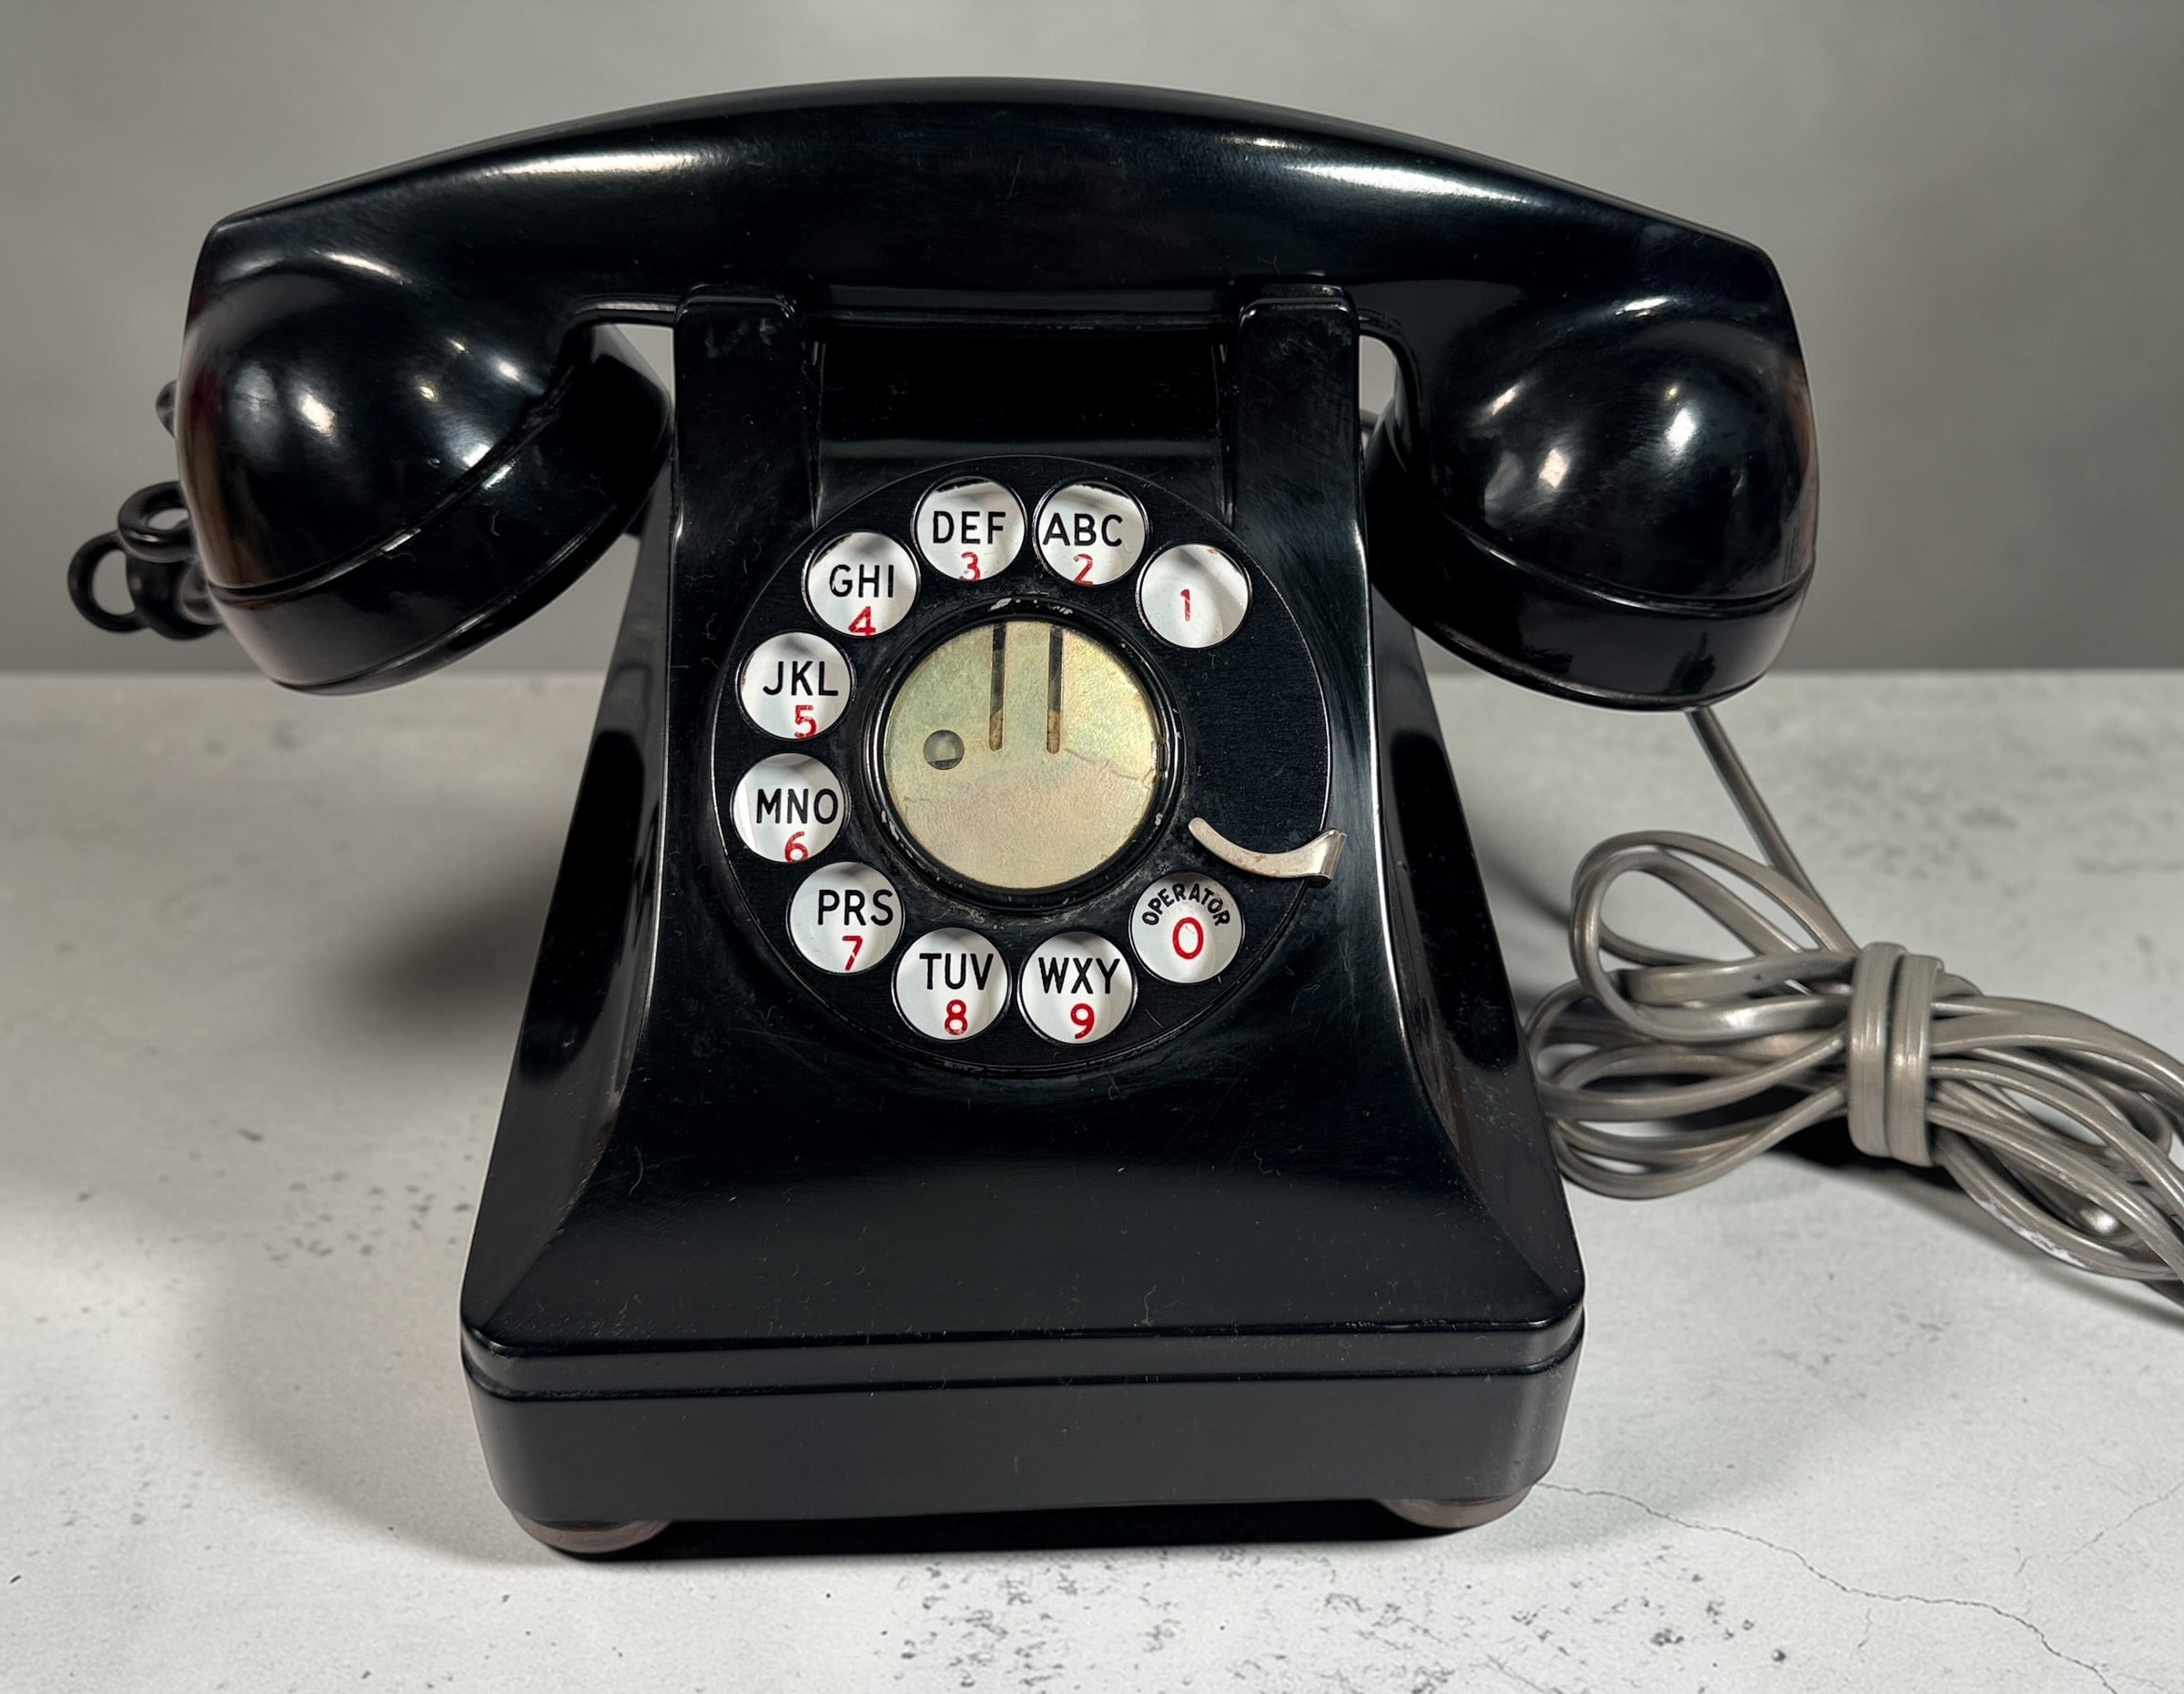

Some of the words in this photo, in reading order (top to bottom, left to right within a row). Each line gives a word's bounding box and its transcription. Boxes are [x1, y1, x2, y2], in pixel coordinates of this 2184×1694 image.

[934, 511, 1005, 544] DEF
[1042, 513, 1122, 547] ABC
[830, 564, 894, 598] GHI
[961, 552, 981, 580] 3
[1074, 554, 1092, 585] 2
[849, 607, 876, 636] 4
[1180, 589, 1191, 620] 1
[763, 661, 838, 696] JKL
[795, 705, 818, 740] 5
[757, 789, 838, 824] MNO
[784, 832, 809, 862] 6
[818, 890, 892, 926] PRS
[1142, 882, 1230, 926] OPERATOR
[843, 935, 864, 971] 7
[1172, 917, 1205, 960] 0
[920, 953, 994, 990] TUV
[1038, 957, 1119, 993] WXY
[945, 999, 968, 1035] 8
[1070, 1003, 1096, 1040] 9
